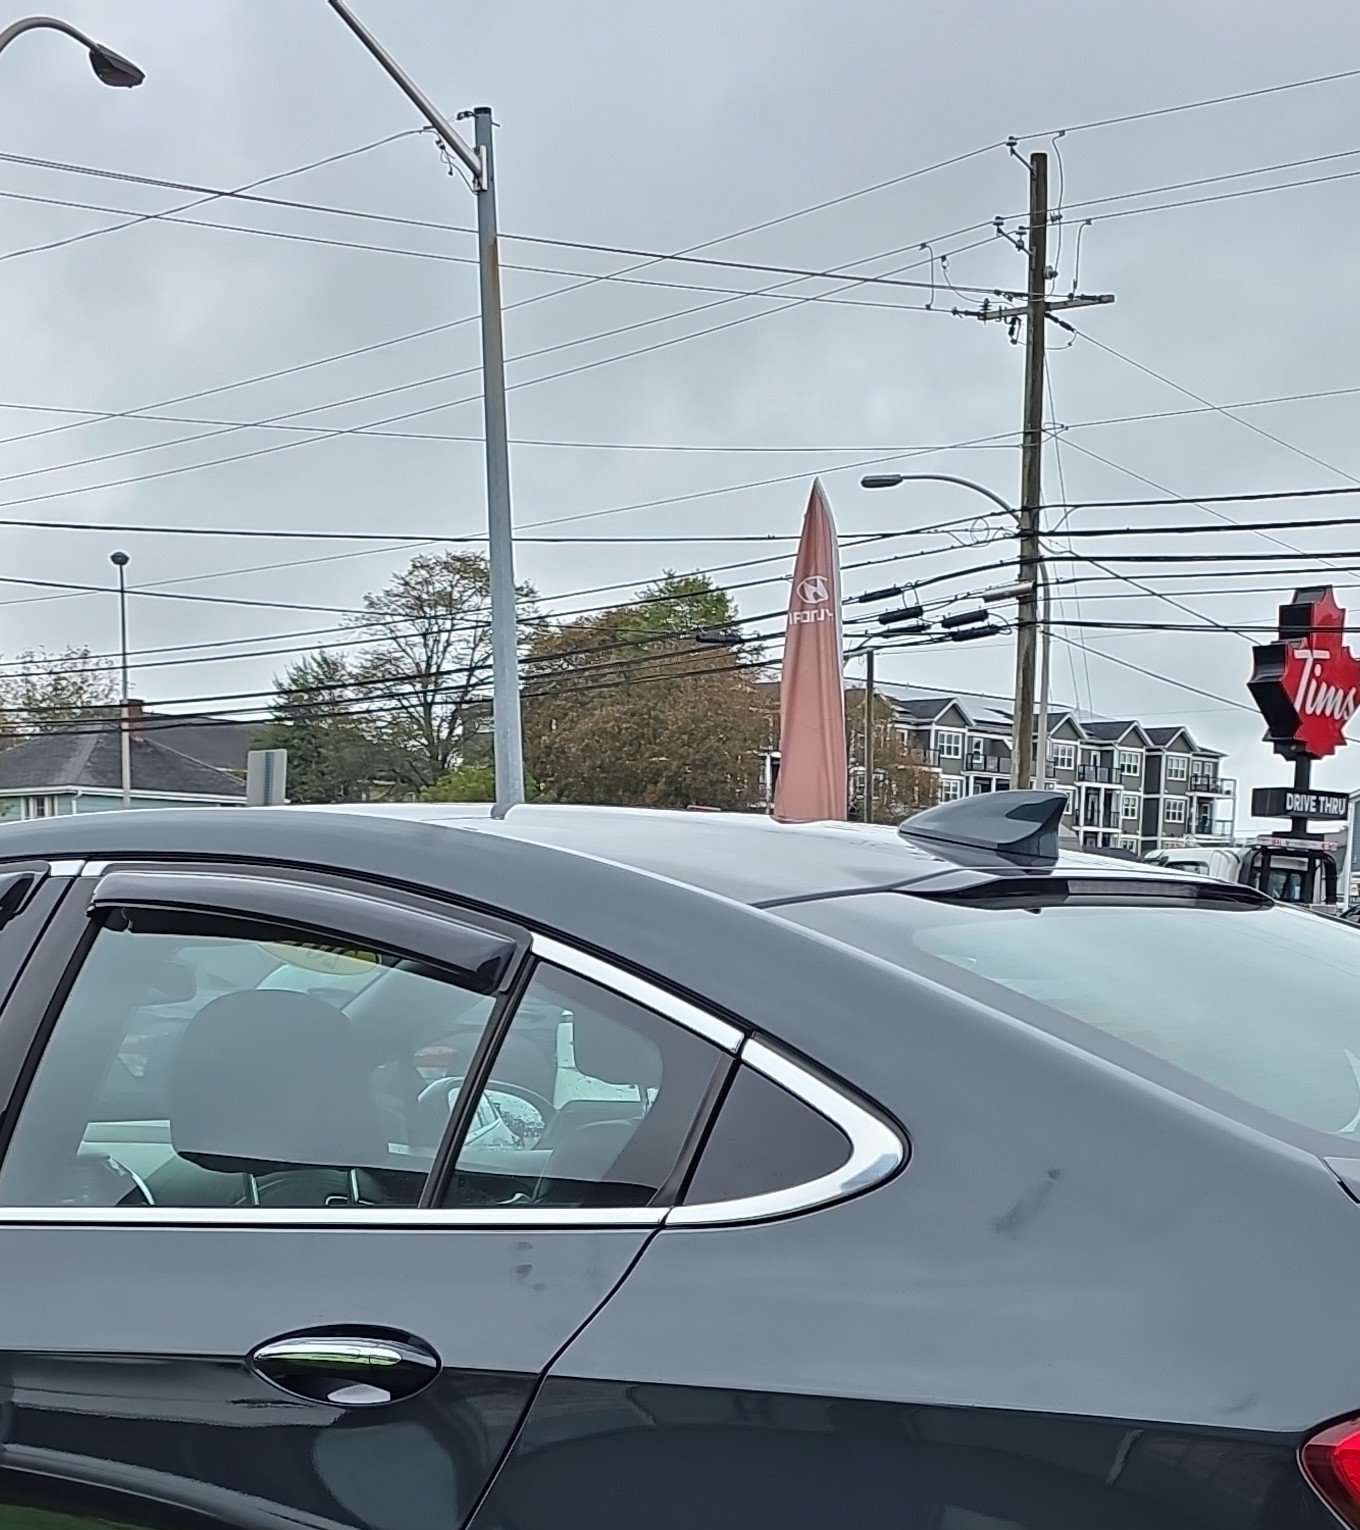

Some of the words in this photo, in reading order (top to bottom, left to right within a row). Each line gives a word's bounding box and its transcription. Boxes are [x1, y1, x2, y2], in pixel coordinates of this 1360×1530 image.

[1294, 649, 1356, 721] Tims
[1285, 793, 1317, 813] DRIVE
[1319, 796, 1346, 815] THRU
